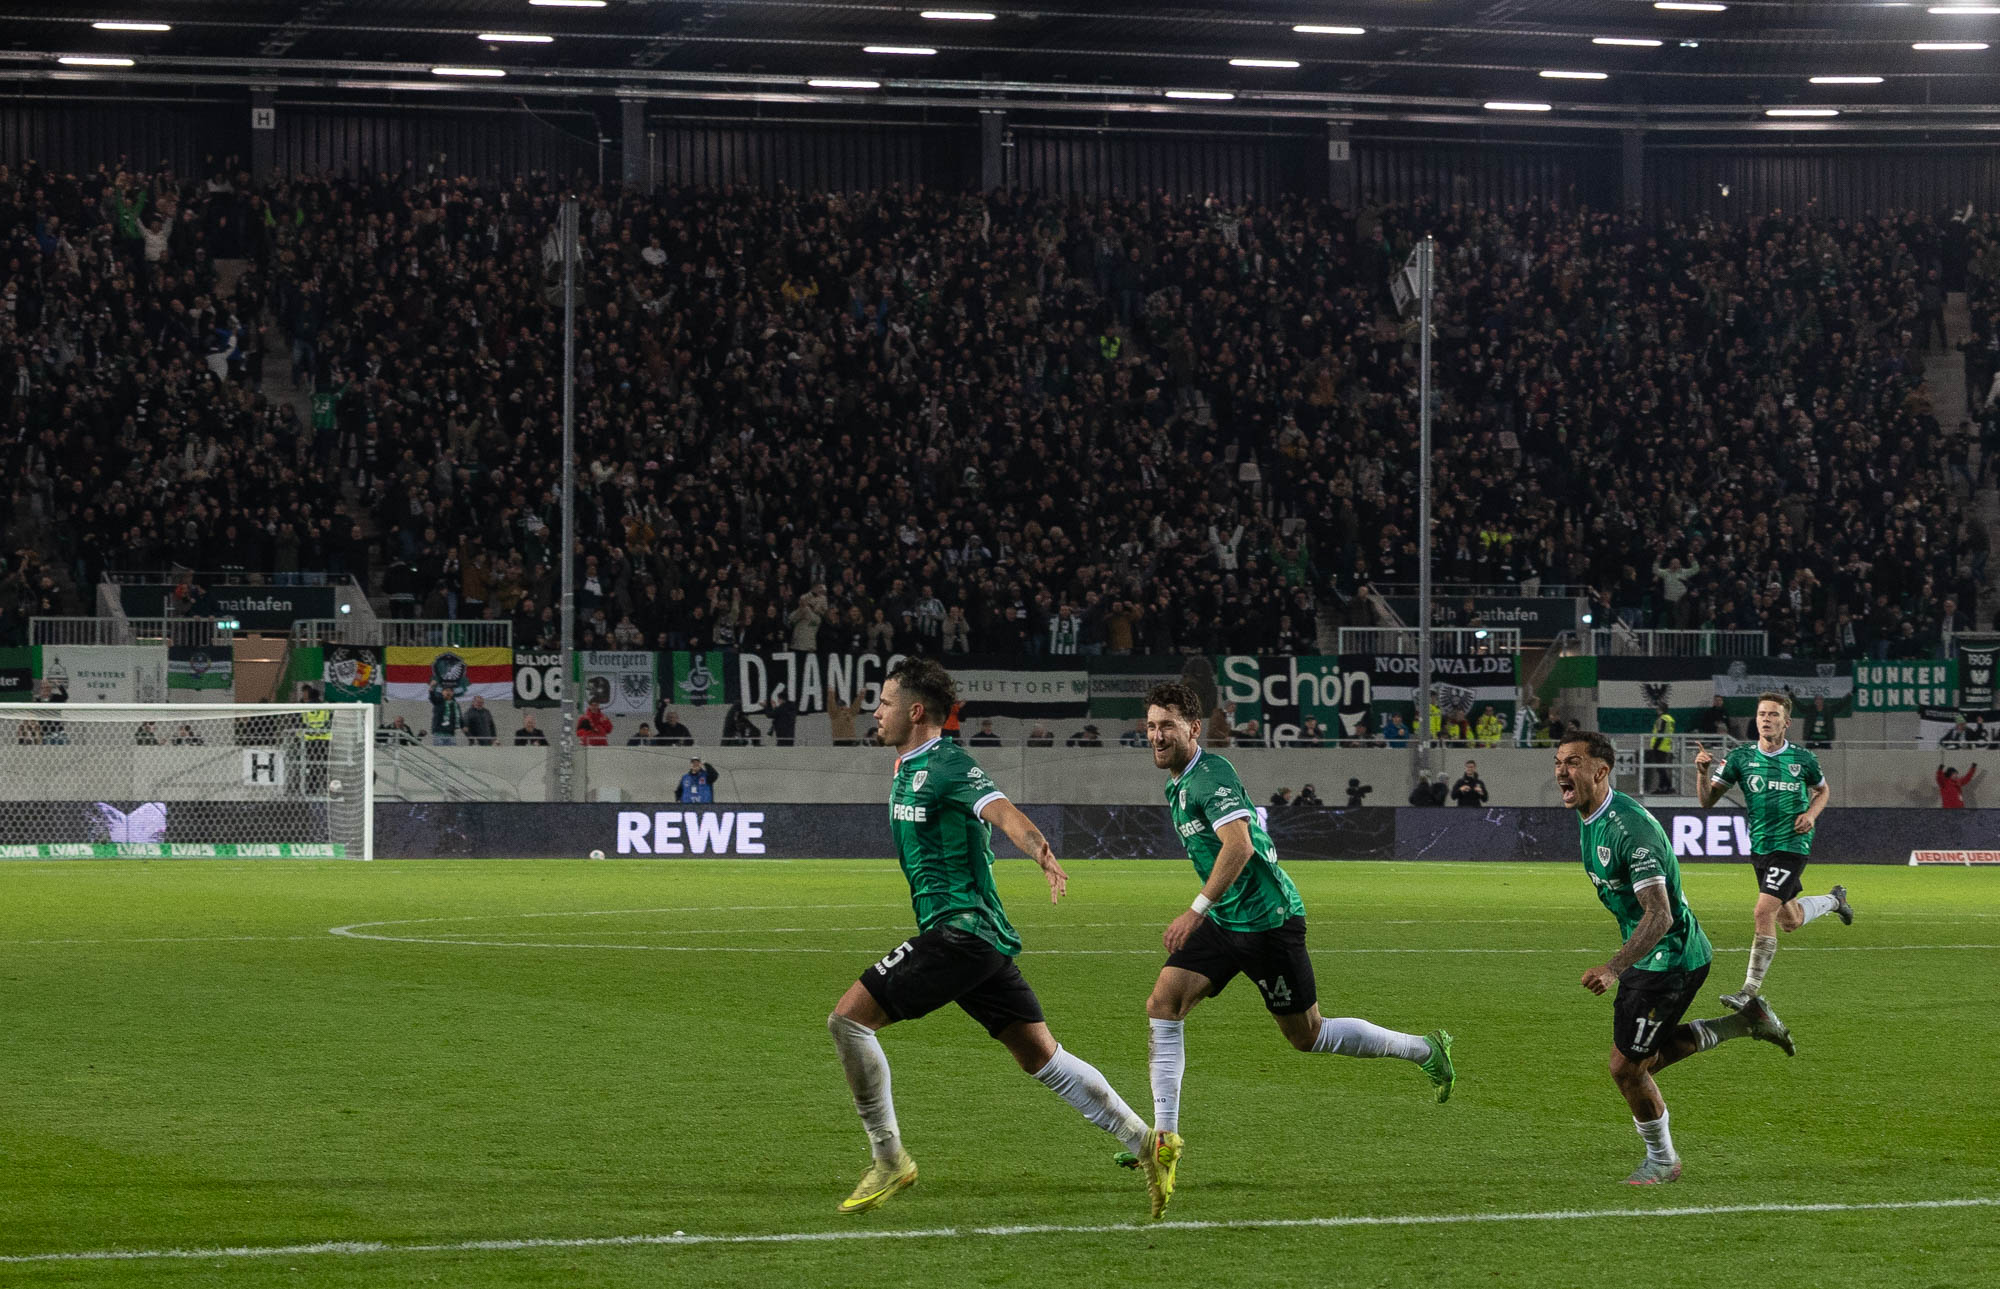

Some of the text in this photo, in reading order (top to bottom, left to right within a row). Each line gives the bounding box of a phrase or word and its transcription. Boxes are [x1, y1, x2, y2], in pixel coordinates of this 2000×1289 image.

[257, 111, 270, 126] H
[217, 596, 293, 612] mathafen
[0, 676, 20, 687] ter
[516, 667, 562, 701] 06
[1224, 655, 1371, 707] Schön
[1858, 688, 1947, 707] BUNKEN
[251, 753, 275, 783] H
[617, 811, 766, 854] REWE
[1178, 819, 1206, 838] EGE
[1672, 815, 1752, 856] RE
[1766, 867, 1792, 886] 27
[882, 941, 914, 968] 5
[874, 962, 887, 976] AKO
[1633, 1017, 1663, 1047] 17
